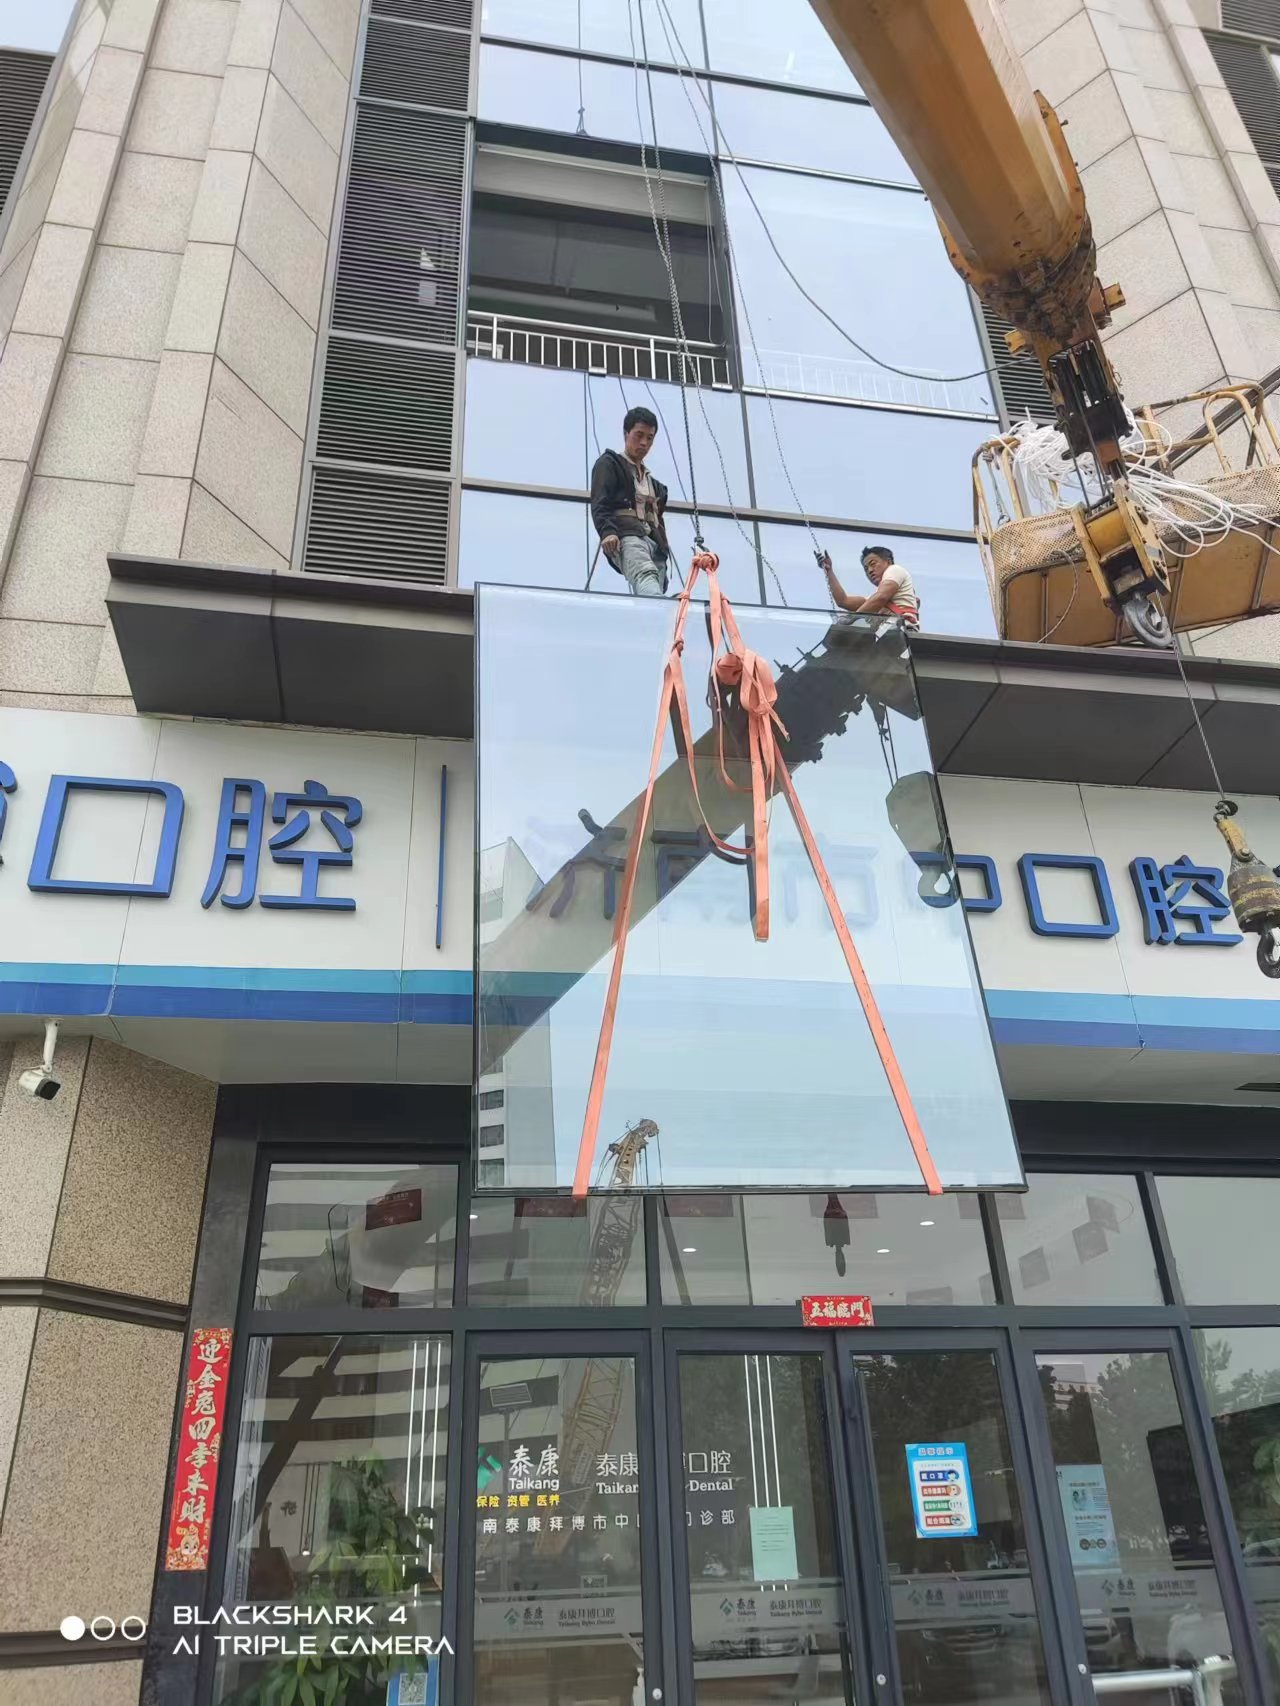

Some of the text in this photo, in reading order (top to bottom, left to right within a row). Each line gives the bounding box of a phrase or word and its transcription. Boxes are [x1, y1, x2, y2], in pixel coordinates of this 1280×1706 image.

[0, 761, 362, 911] 口腔
[509, 1444, 560, 1478] 泰康
[509, 1478, 560, 1491] Taikang
[689, 1479, 734, 1491] Dental
[476, 1494, 561, 1508] 保险 资管 医养
